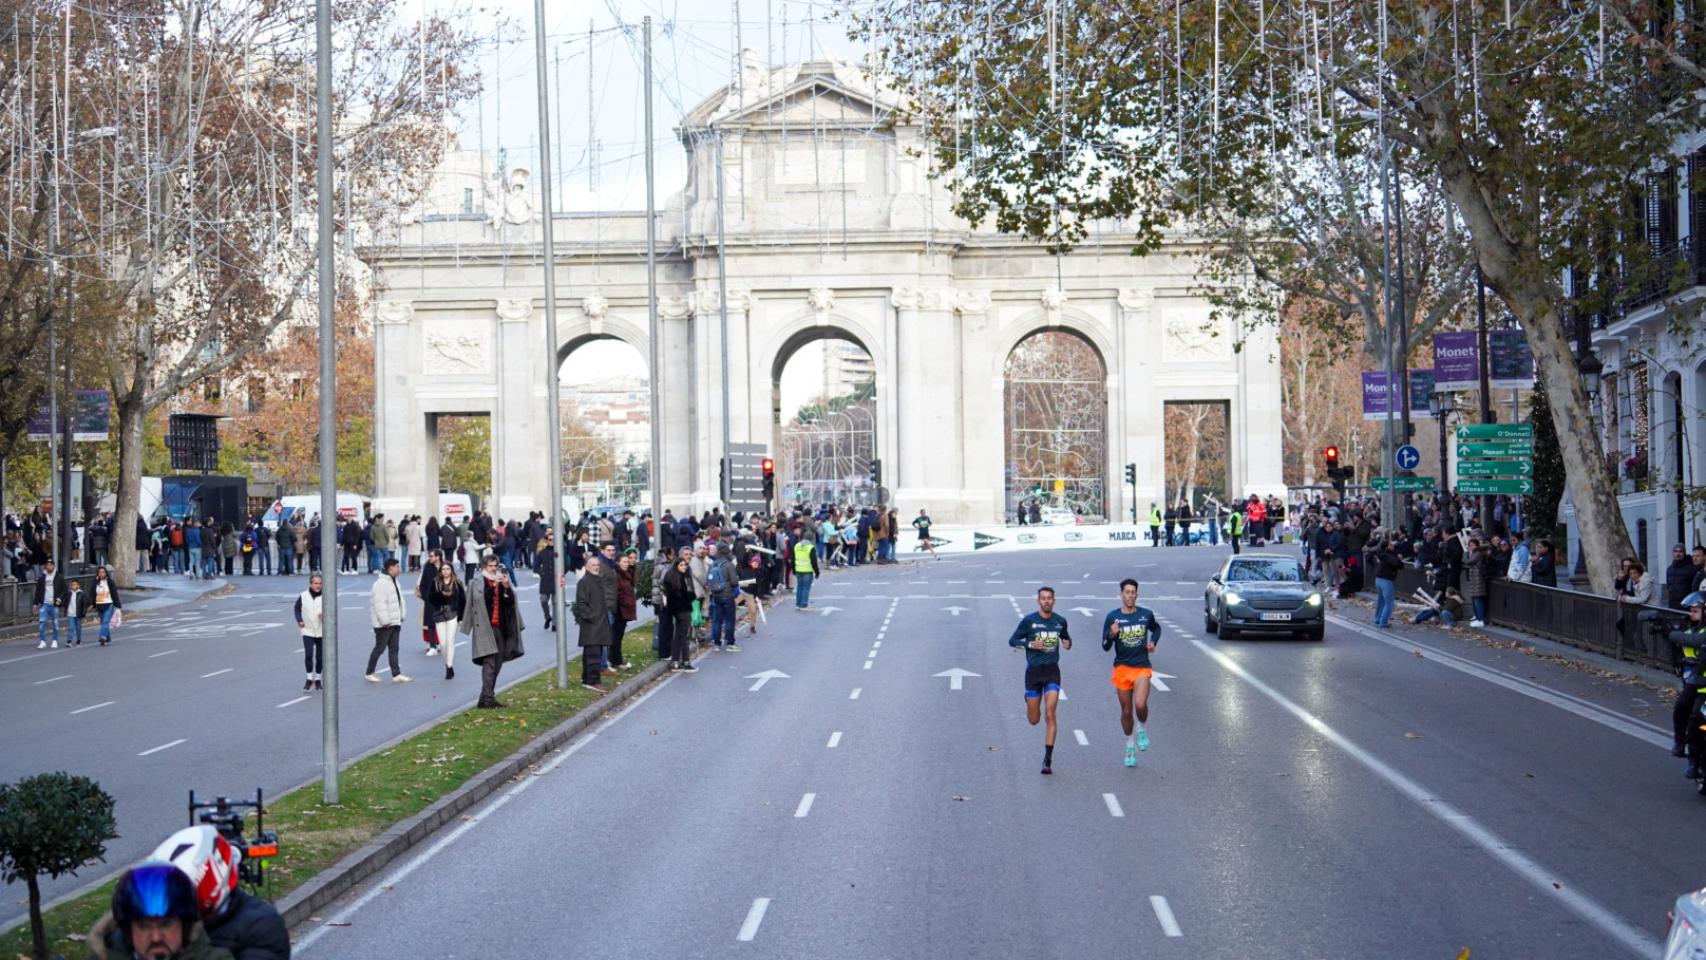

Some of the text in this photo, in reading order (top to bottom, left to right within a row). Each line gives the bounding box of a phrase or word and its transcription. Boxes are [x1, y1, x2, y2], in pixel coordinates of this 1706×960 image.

[1436, 346, 1474, 358] Monet
[1365, 383, 1397, 393] Mont
[1109, 531, 1136, 541] MARCA
